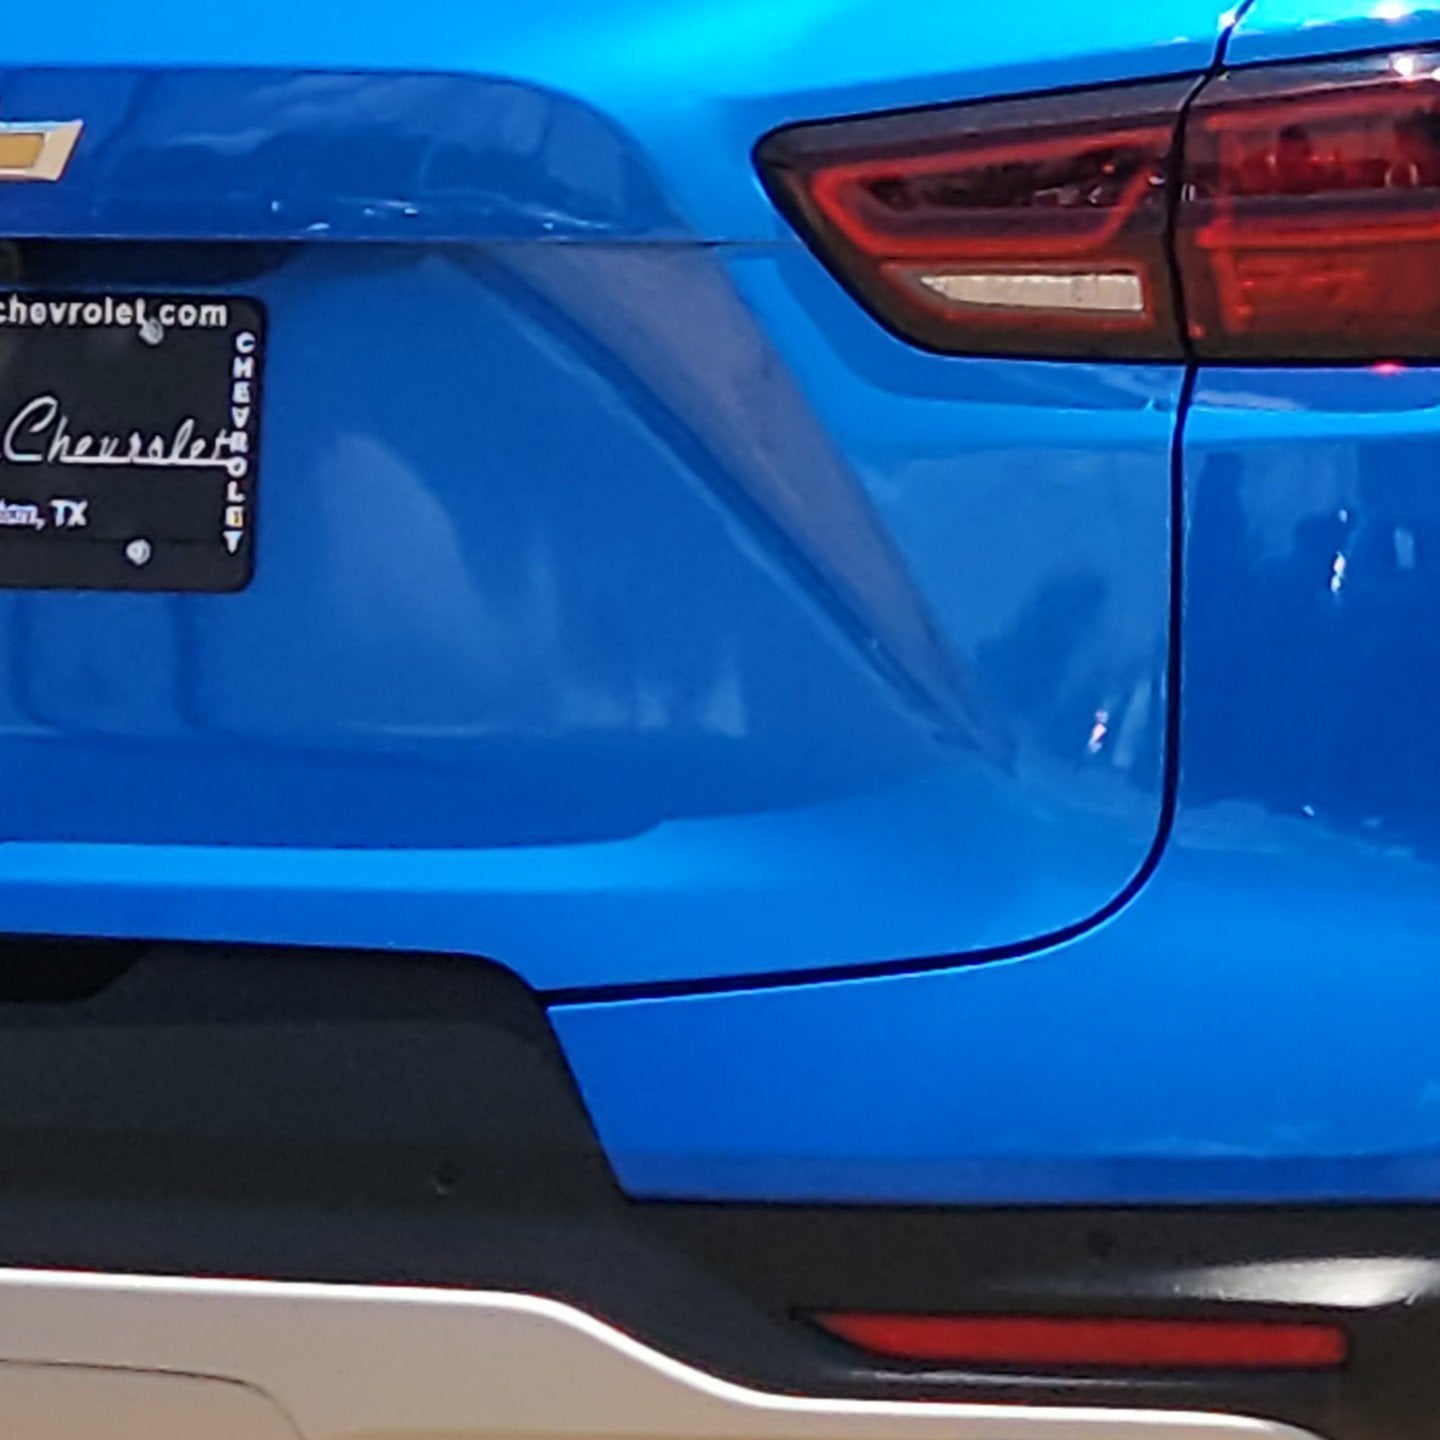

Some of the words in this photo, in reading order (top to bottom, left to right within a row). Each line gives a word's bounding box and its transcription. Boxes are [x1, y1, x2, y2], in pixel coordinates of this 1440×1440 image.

[3, 395, 233, 466] Chevrolet
[223, 332, 257, 554] CHEVROLET
[50, 498, 88, 527] TX
